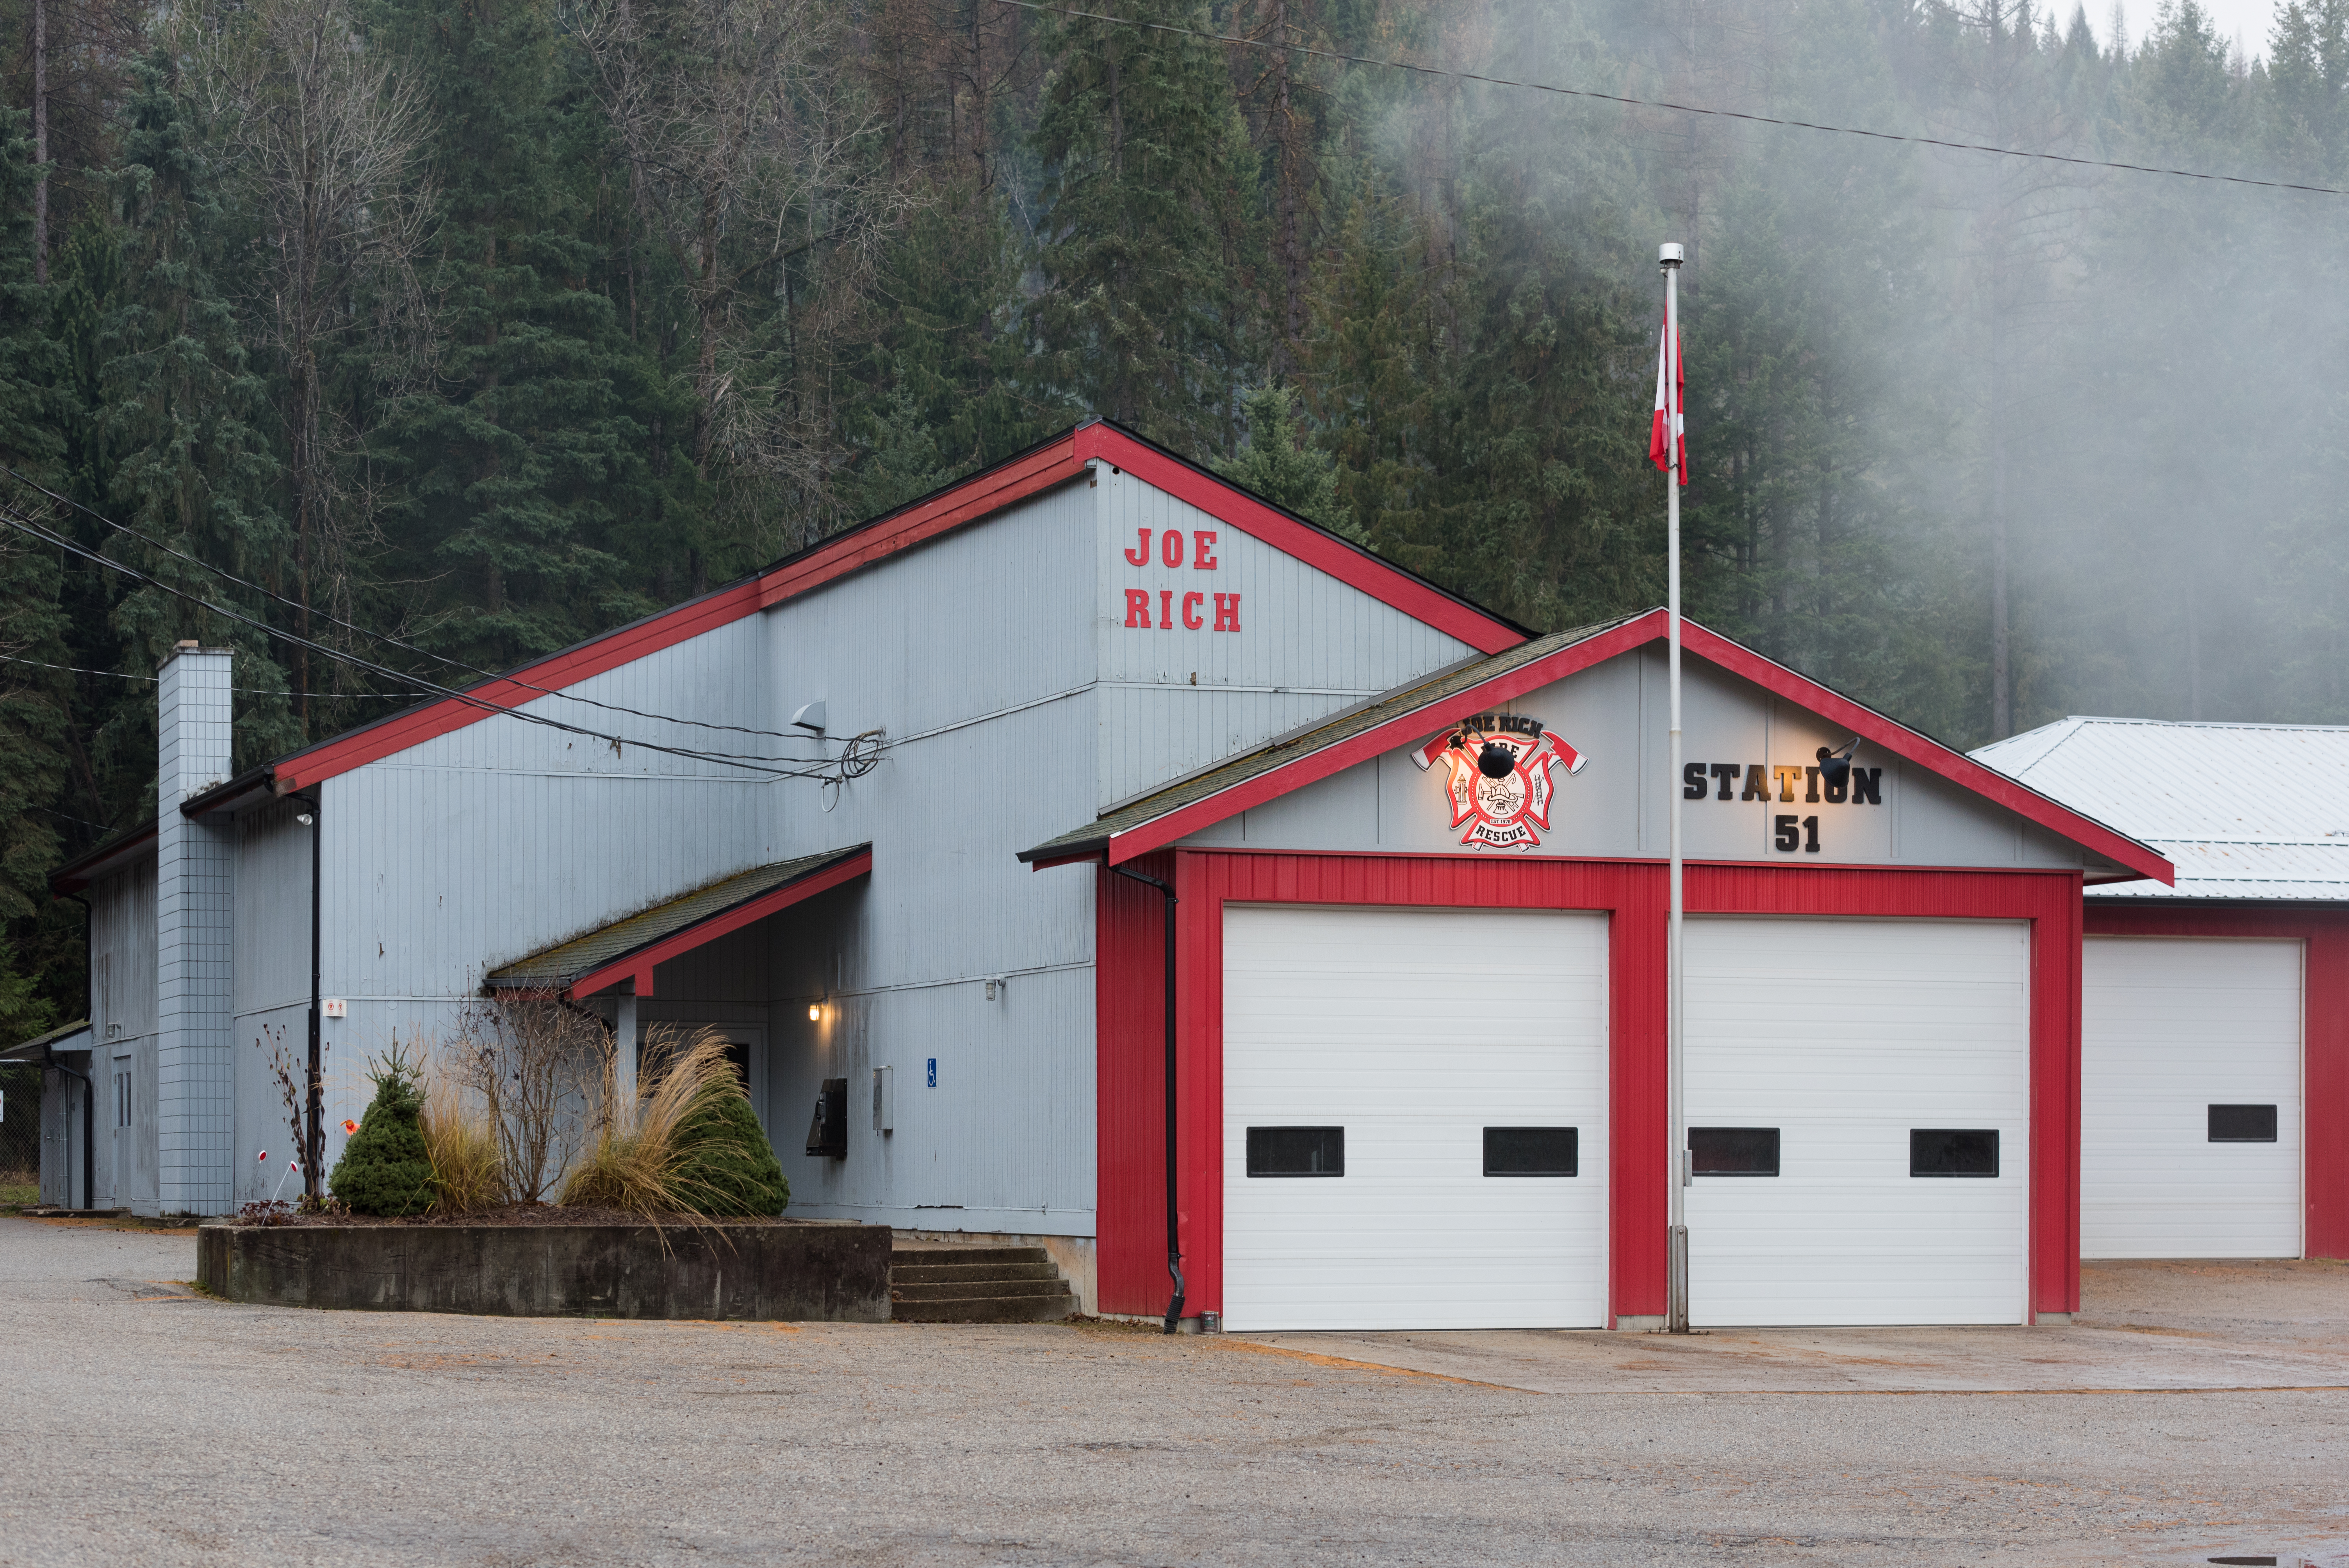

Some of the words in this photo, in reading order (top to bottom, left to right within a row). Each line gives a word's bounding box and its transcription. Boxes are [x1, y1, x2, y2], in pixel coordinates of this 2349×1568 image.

[1125, 528, 1217, 570] JOE
[1125, 589, 1240, 632] RICH
[1461, 716, 1495, 735] JOE
[1499, 716, 1543, 739] RICH
[1476, 825, 1526, 841] RESCUE
[1775, 815, 1820, 852] 51
